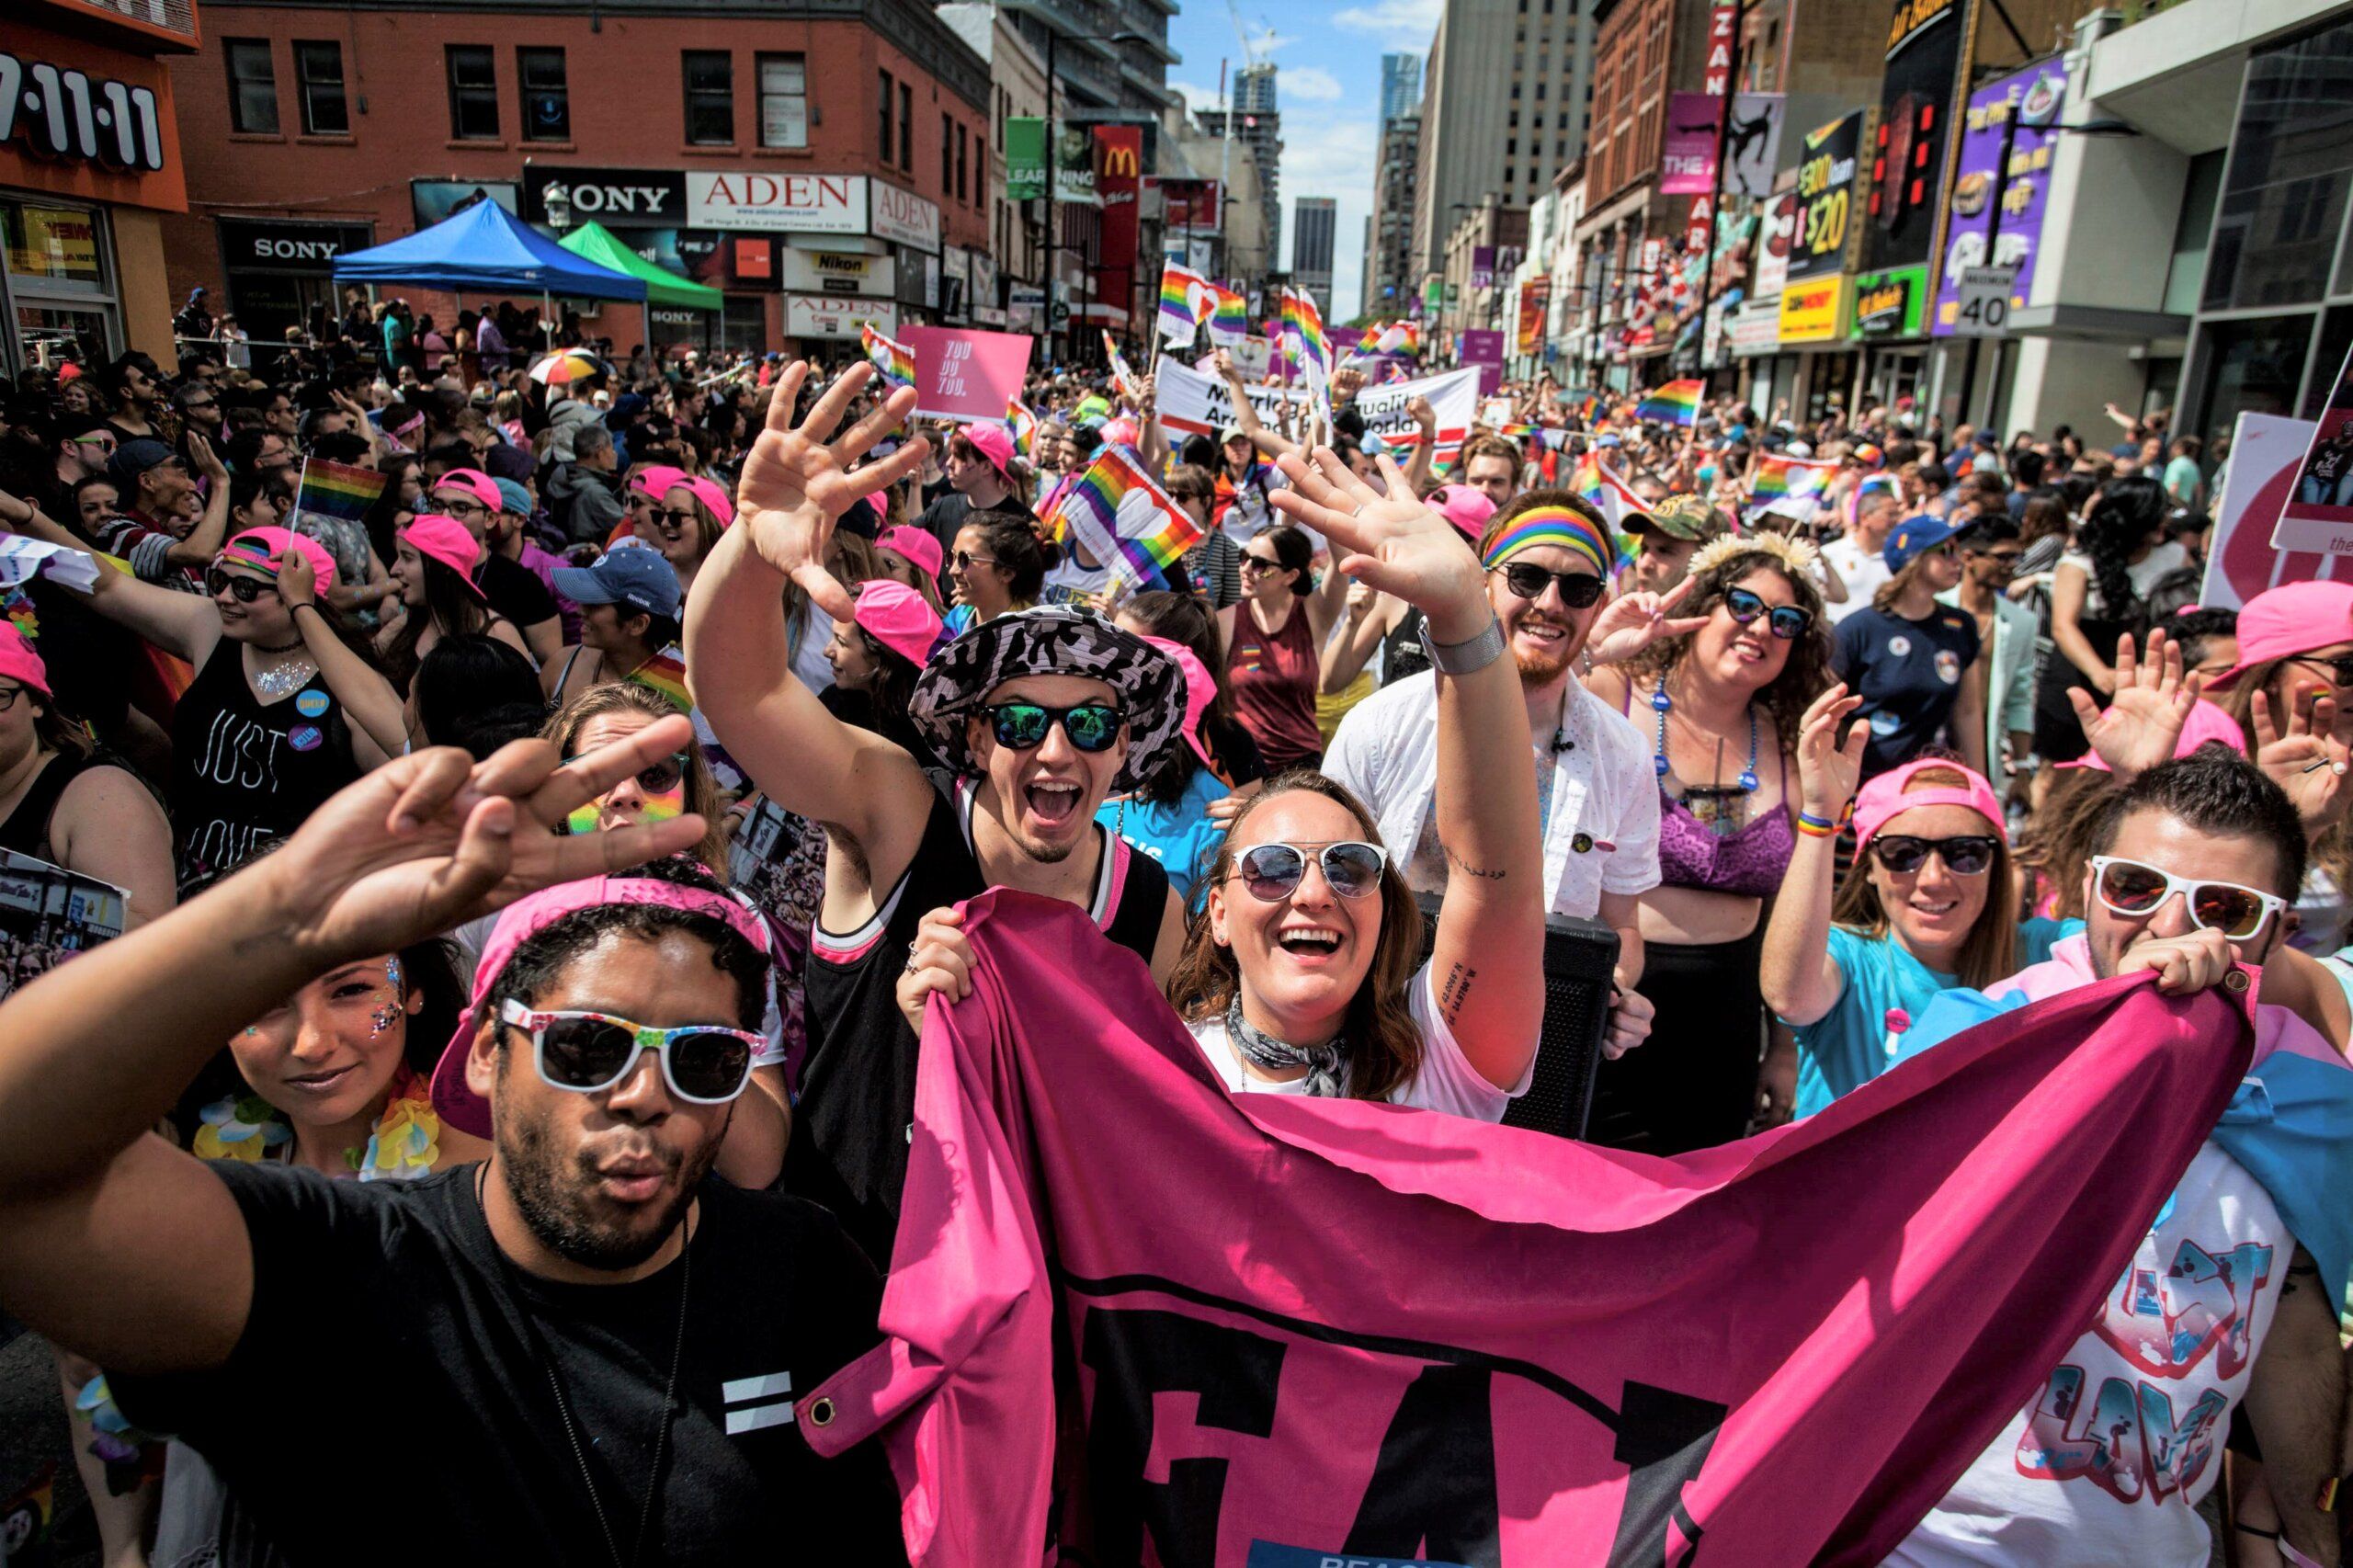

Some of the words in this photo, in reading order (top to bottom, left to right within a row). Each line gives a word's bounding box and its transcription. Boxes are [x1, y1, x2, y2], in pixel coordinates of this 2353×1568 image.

[704, 174, 853, 209] ADEN
[879, 185, 933, 232] ADEN
[1806, 188, 1849, 256] $20
[255, 238, 339, 260] SONY
[818, 255, 862, 271] Nikon
[1965, 274, 2010, 285] MAXIMUM
[651, 311, 694, 323] SONY
[794, 298, 892, 315] ADEN
[1961, 297, 2006, 327] 40
[193, 708, 287, 793] JUST
[2092, 1238, 2274, 1381] UST
